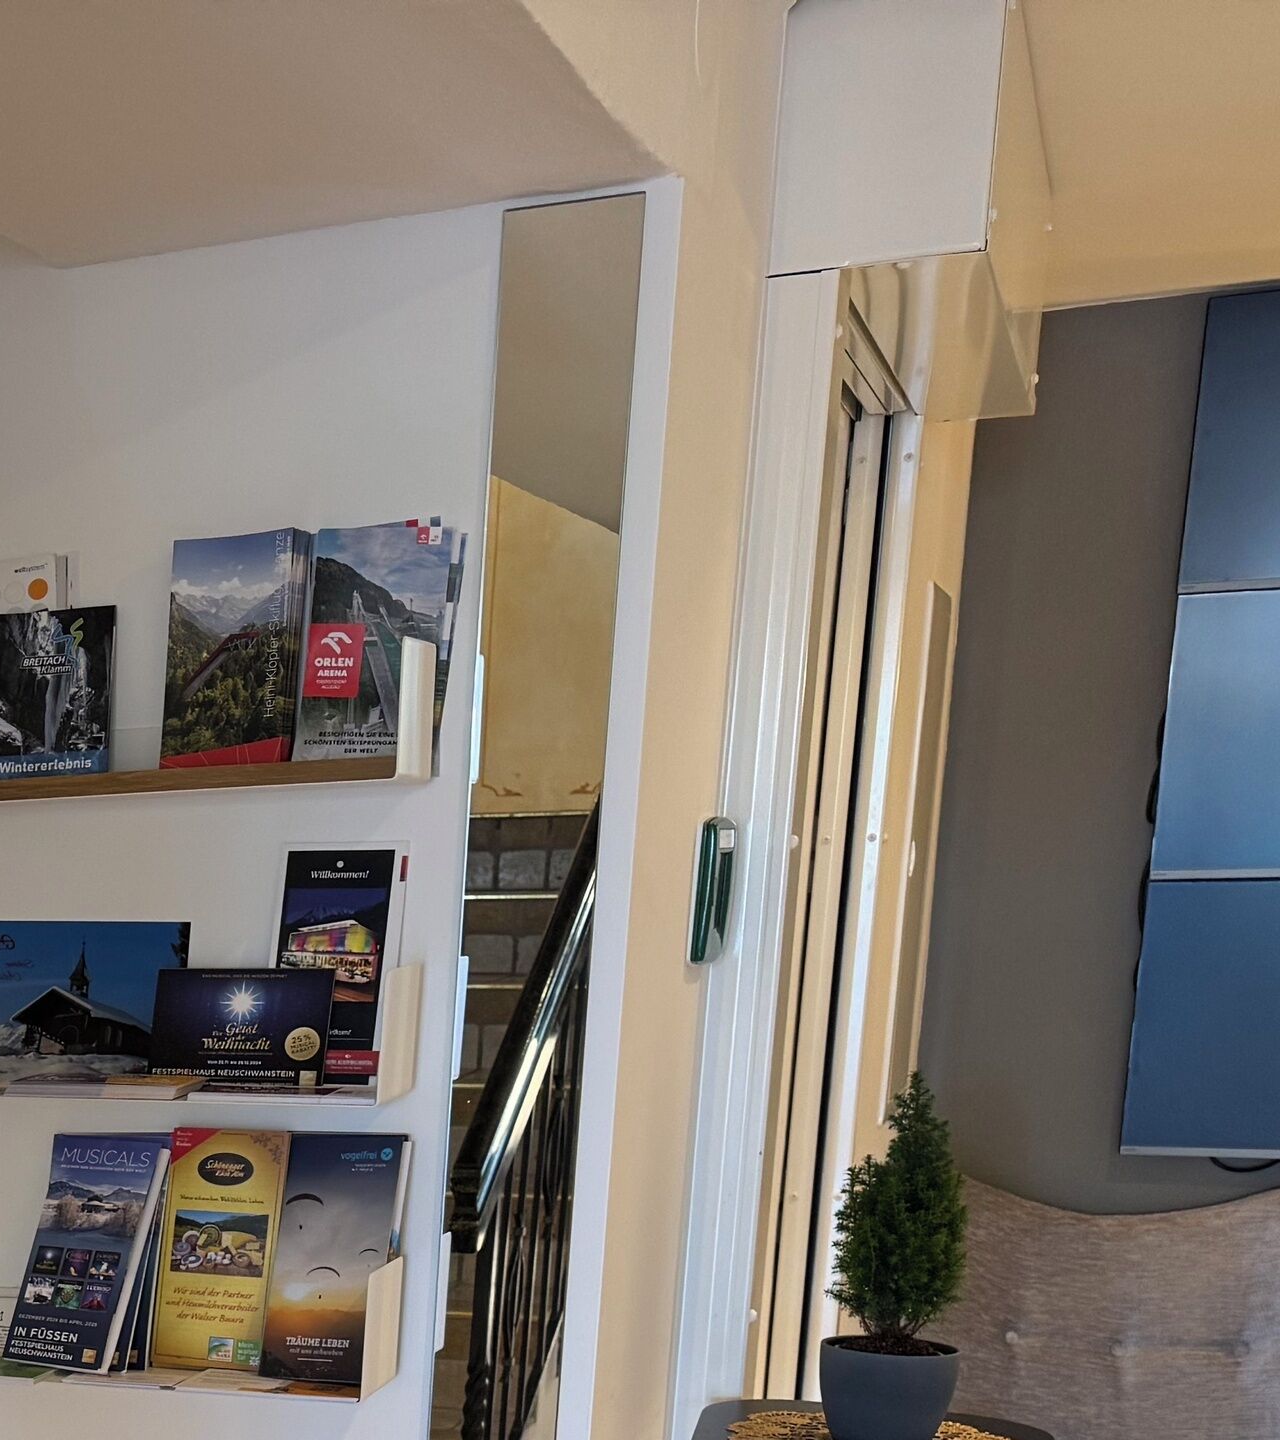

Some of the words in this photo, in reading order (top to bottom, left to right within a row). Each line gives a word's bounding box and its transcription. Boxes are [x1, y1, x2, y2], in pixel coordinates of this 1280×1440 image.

[23, 655, 65, 668] BREITACH
[314, 657, 354, 667] ORLEN
[317, 669, 348, 677] ARENA
[0, 757, 92, 774] Wintererlebnis
[310, 870, 370, 879] Willkommen!
[226, 1022, 258, 1035] Geist
[202, 1037, 272, 1051] Weihnacht
[151, 1067, 216, 1076] FESTSPIELHAUS
[217, 1069, 295, 1078] NEUSCHWANSTEIN
[61, 1147, 151, 1168] MUSICALS
[340, 1151, 377, 1161] vogelfrei
[189, 1288, 206, 1296] sind
[207, 1288, 220, 1297] der
[222, 1290, 255, 1300] Partner
[165, 1298, 180, 1306] und
[176, 1311, 189, 1319] der
[191, 1312, 218, 1321] Walser
[13, 1326, 27, 1337] IN
[30, 1328, 79, 1343] FÜSSEN
[11, 1340, 64, 1352] FESTSPIELHAUS
[286, 1335, 321, 1347] TRÄUME
[322, 1339, 350, 1348] LEBEN
[9, 1347, 73, 1361] NEUSCHWANSTEIN
